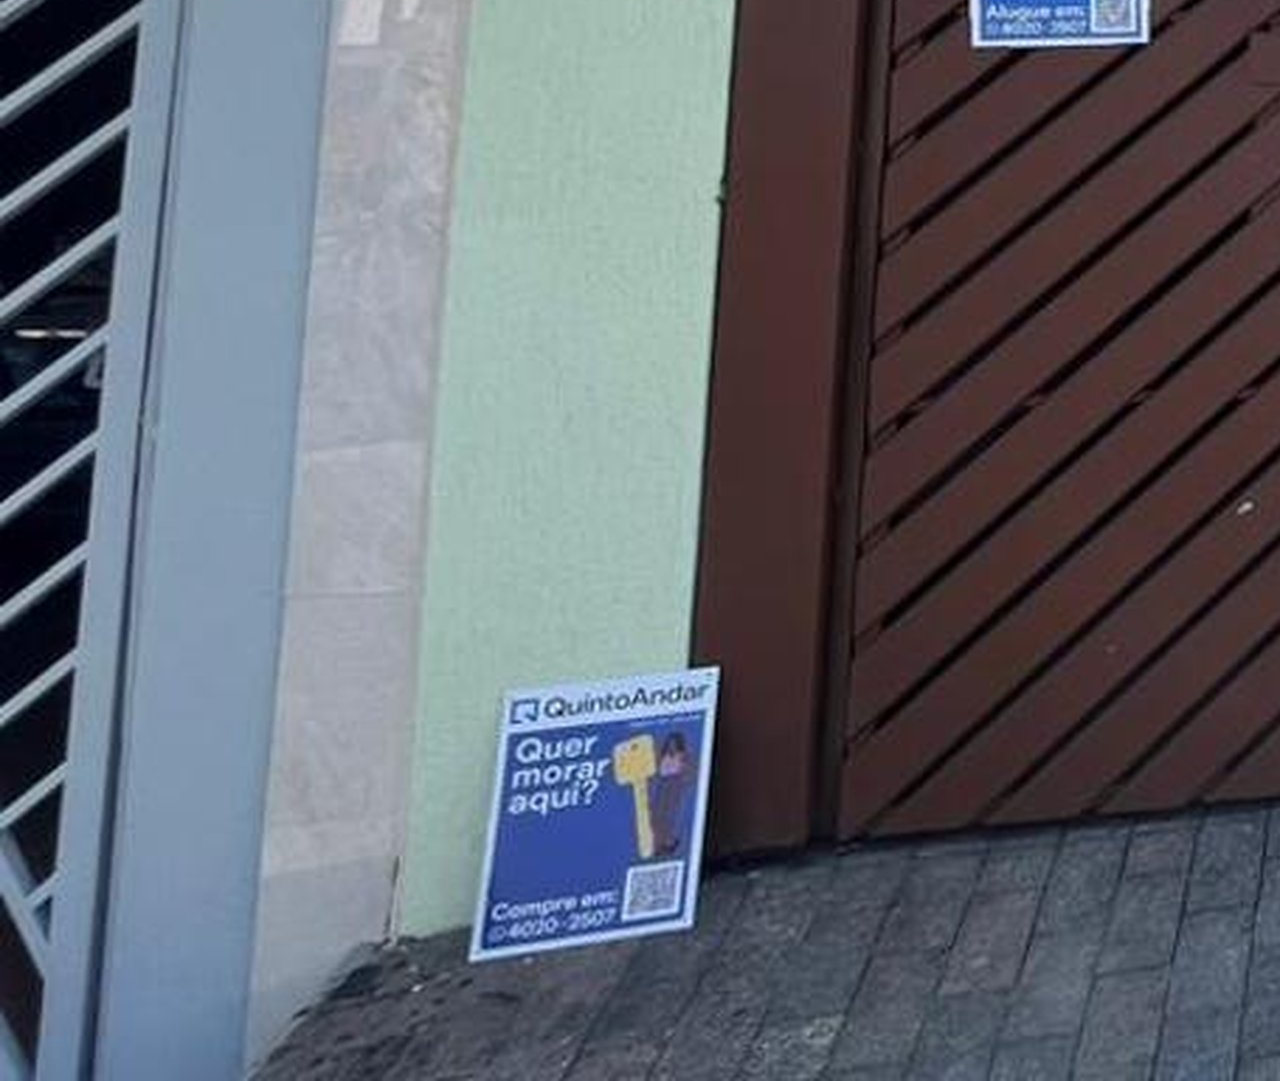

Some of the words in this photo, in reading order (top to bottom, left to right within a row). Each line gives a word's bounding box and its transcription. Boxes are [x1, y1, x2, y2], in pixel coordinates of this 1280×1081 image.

[544, 683, 710, 719] QuintoAndar
[516, 735, 599, 764] Quer
[511, 757, 612, 788] morar
[508, 780, 599, 816] aqui?
[491, 897, 578, 921] Compre
